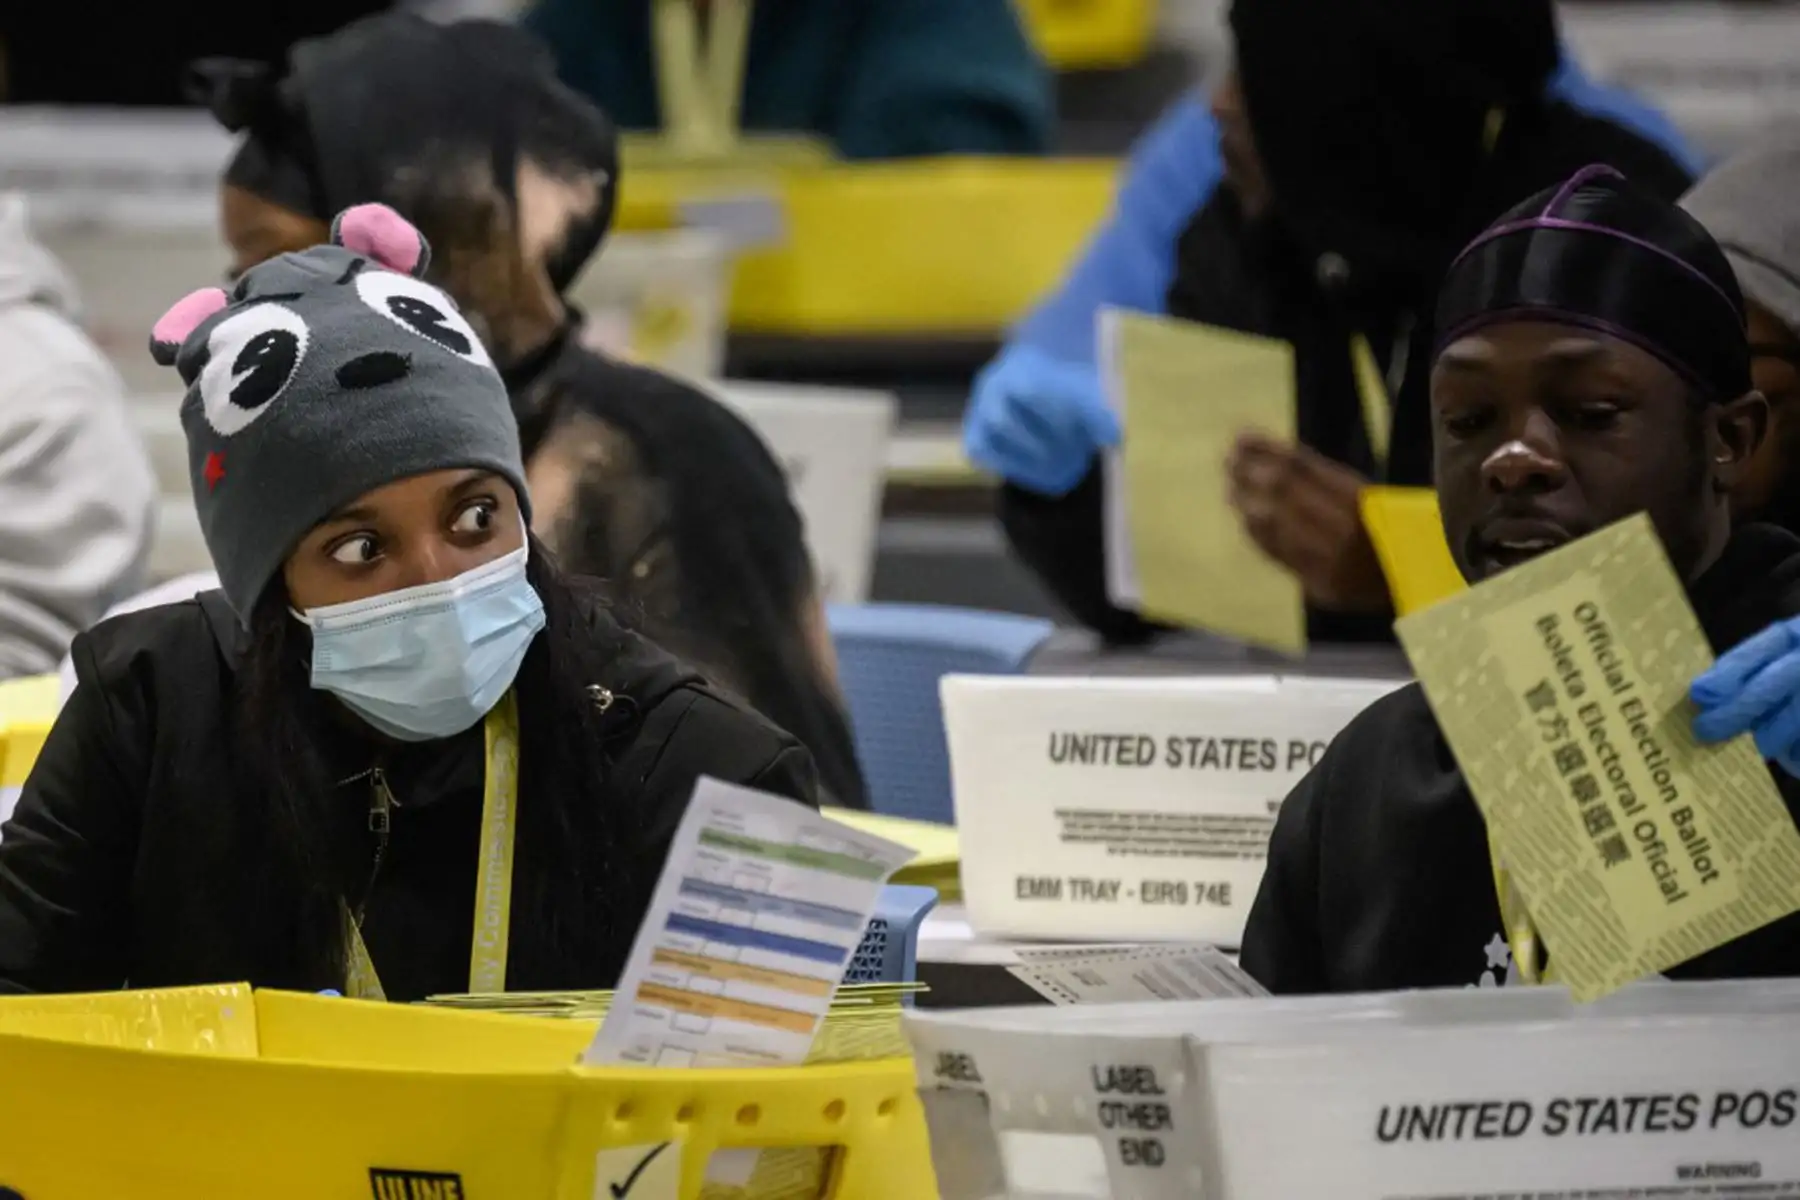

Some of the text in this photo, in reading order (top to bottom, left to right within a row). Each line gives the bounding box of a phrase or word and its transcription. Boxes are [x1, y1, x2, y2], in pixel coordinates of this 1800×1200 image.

[1048, 731, 1157, 769] UNITED
[1164, 735, 1278, 773] STATES
[1534, 612, 1690, 906] Boleta Electoral Oficial
[1573, 600, 1720, 885] Official Election Ballot
[1015, 874, 1063, 901] EMM
[1067, 875, 1122, 904] TRAY
[1193, 880, 1233, 907] 74E
[1091, 1064, 1166, 1096] LABEL
[1098, 1100, 1175, 1131] OTHER
[1376, 1100, 1534, 1144] UNITED
[1541, 1092, 1702, 1138] STATES
[1117, 1136, 1166, 1168] END
[1675, 1161, 1762, 1181] WARNING
